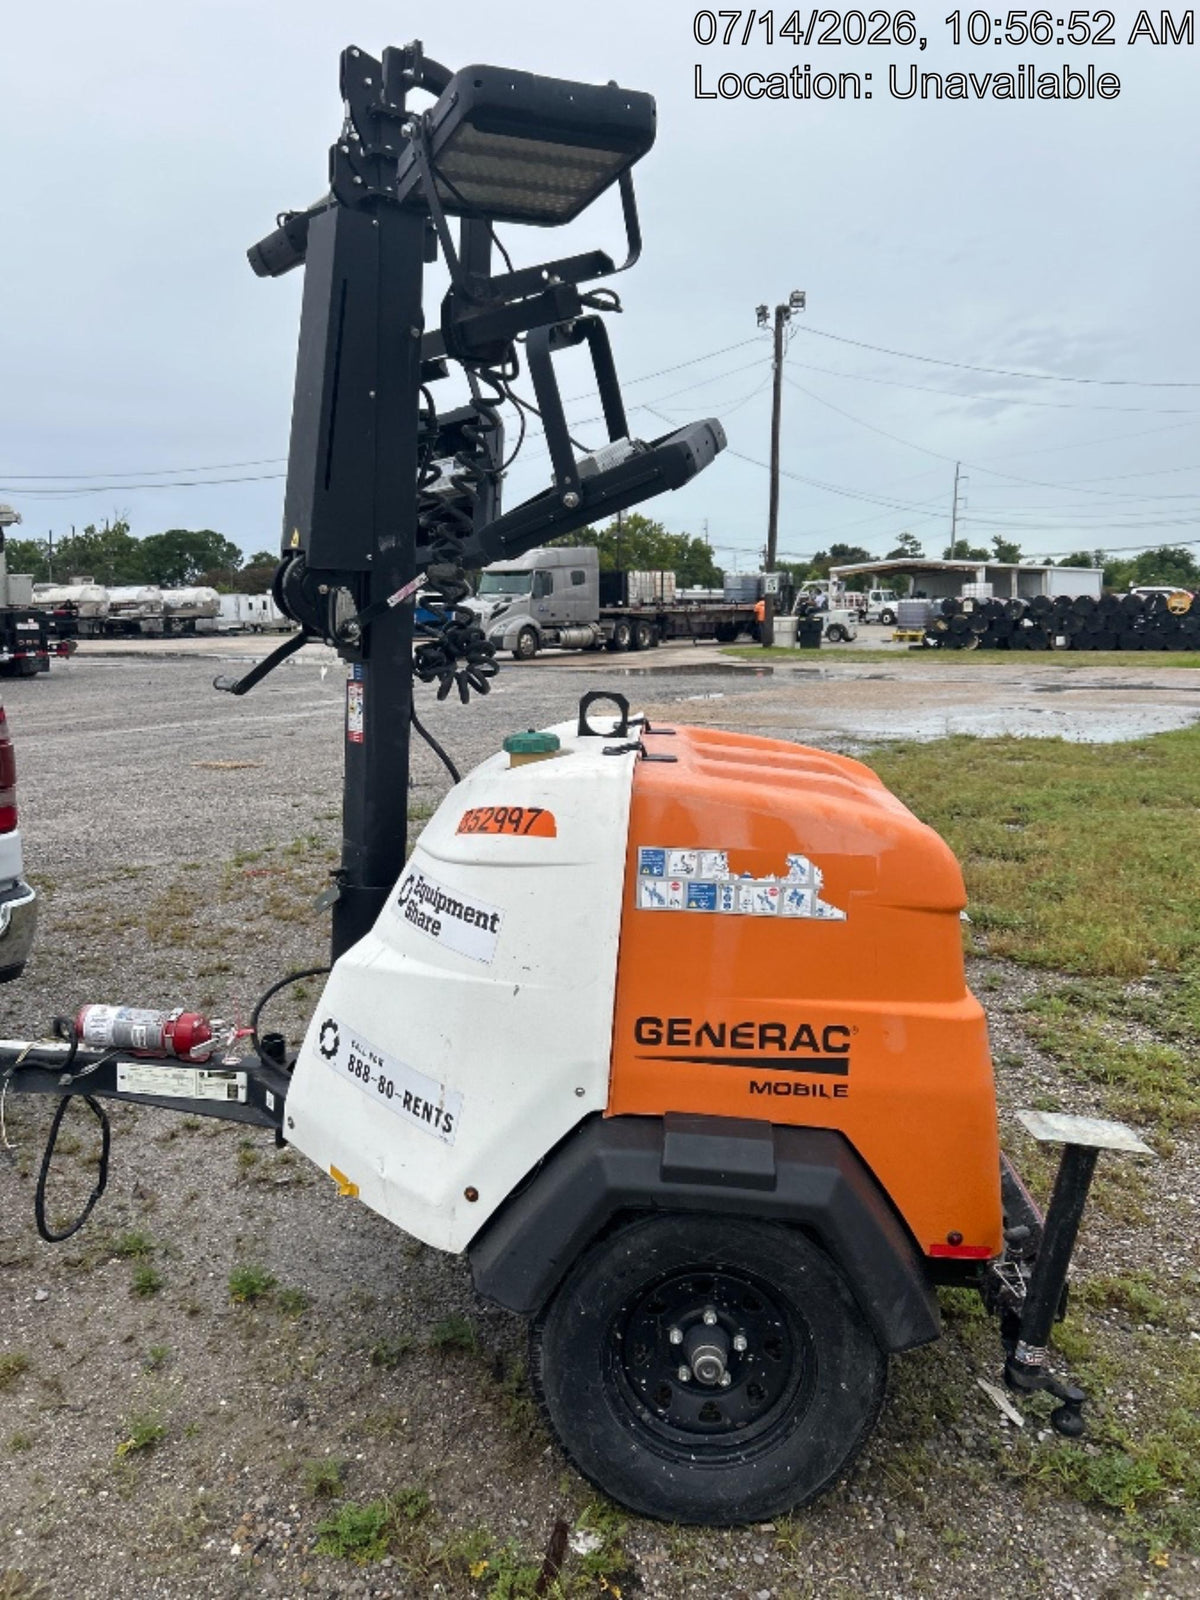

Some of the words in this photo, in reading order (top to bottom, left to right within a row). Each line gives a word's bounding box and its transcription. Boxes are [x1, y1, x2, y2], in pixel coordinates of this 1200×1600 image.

[404, 901, 442, 937] Share
[413, 876, 500, 934] Equipment
[634, 1016, 850, 1053] GENERAC
[347, 1053, 454, 1134] 888-80-RENTS
[749, 1081, 848, 1099] MOBILE
